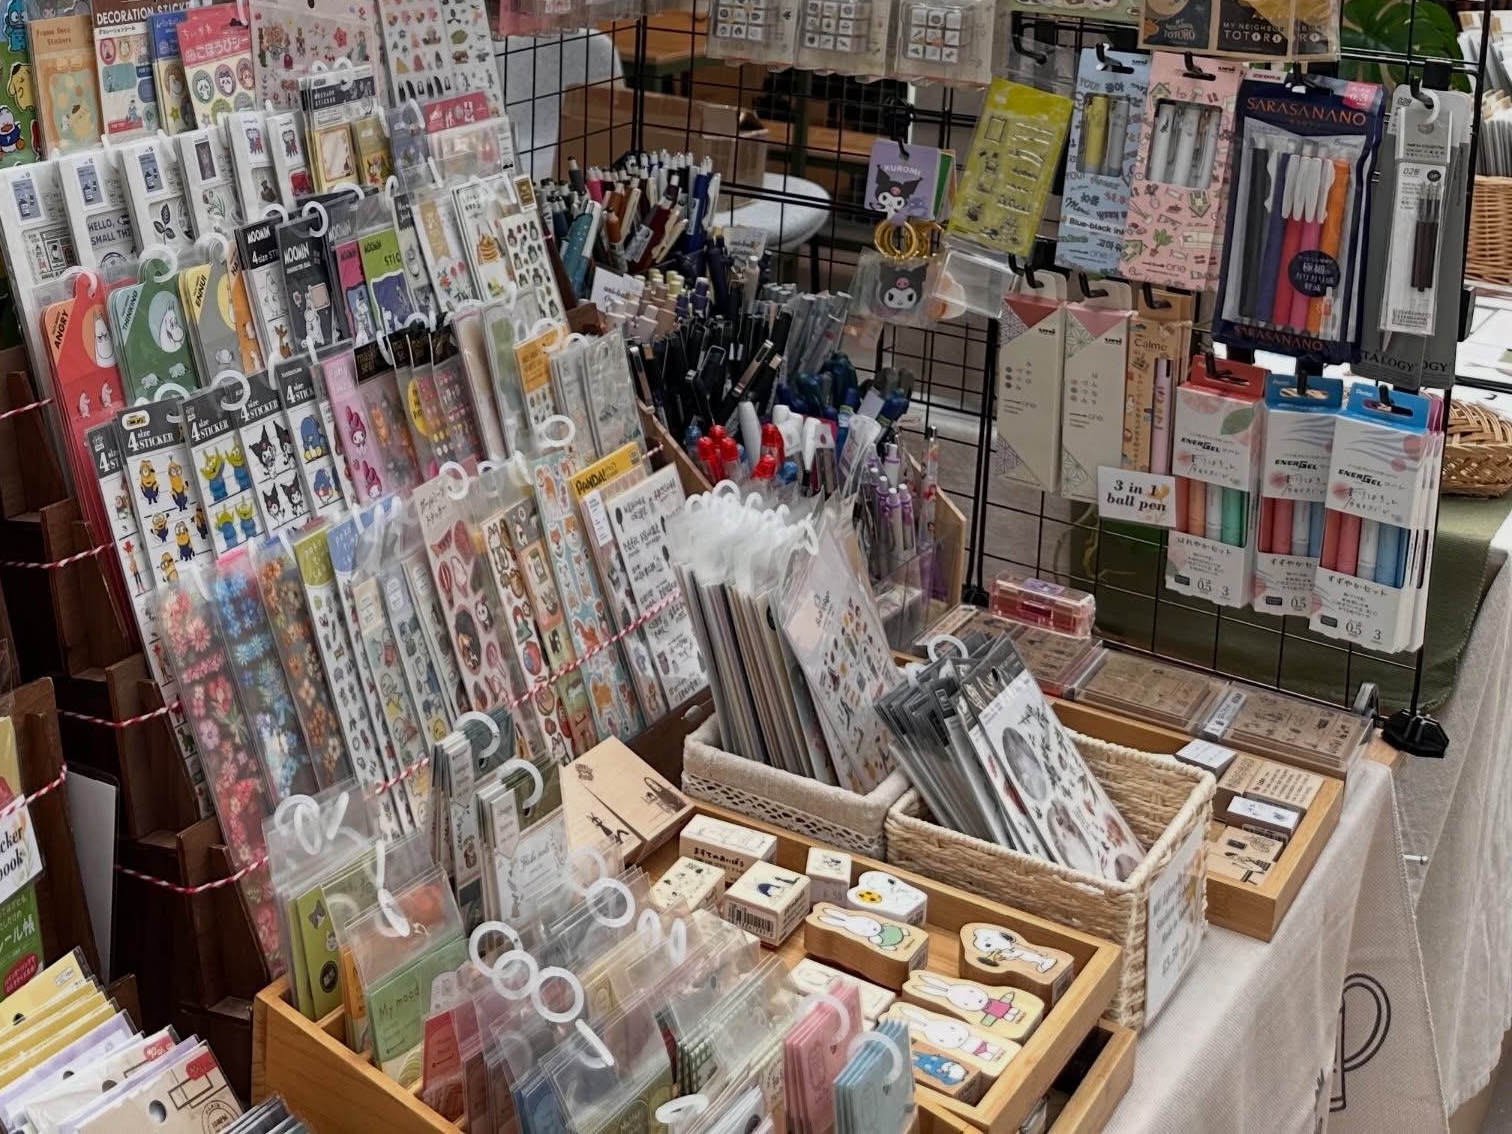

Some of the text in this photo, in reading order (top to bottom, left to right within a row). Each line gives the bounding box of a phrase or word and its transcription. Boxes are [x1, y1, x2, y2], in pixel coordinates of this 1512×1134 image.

[96, 6, 154, 26] DECORATION
[46, 35, 72, 45] Stickers
[1252, 72, 1281, 81] ZEBRA
[1246, 97, 1367, 128] SARASANANO
[883, 163, 921, 176] KUROMI
[88, 217, 116, 233] HELLO,
[247, 225, 271, 245] MOOMIN
[283, 242, 310, 264] MOOMIN
[194, 274, 207, 308] ENNUI
[121, 288, 139, 331] THINKING
[53, 309, 69, 350] ANGRY
[1104, 336, 1123, 346] uni
[1134, 338, 1168, 352] Calme
[127, 429, 174, 453] 4 size STICKER
[1274, 457, 1318, 471] ENERGEL
[1337, 466, 1383, 487] ENERGEL
[1113, 478, 1159, 496] 3 in 1
[1107, 491, 1167, 514] ball pen
